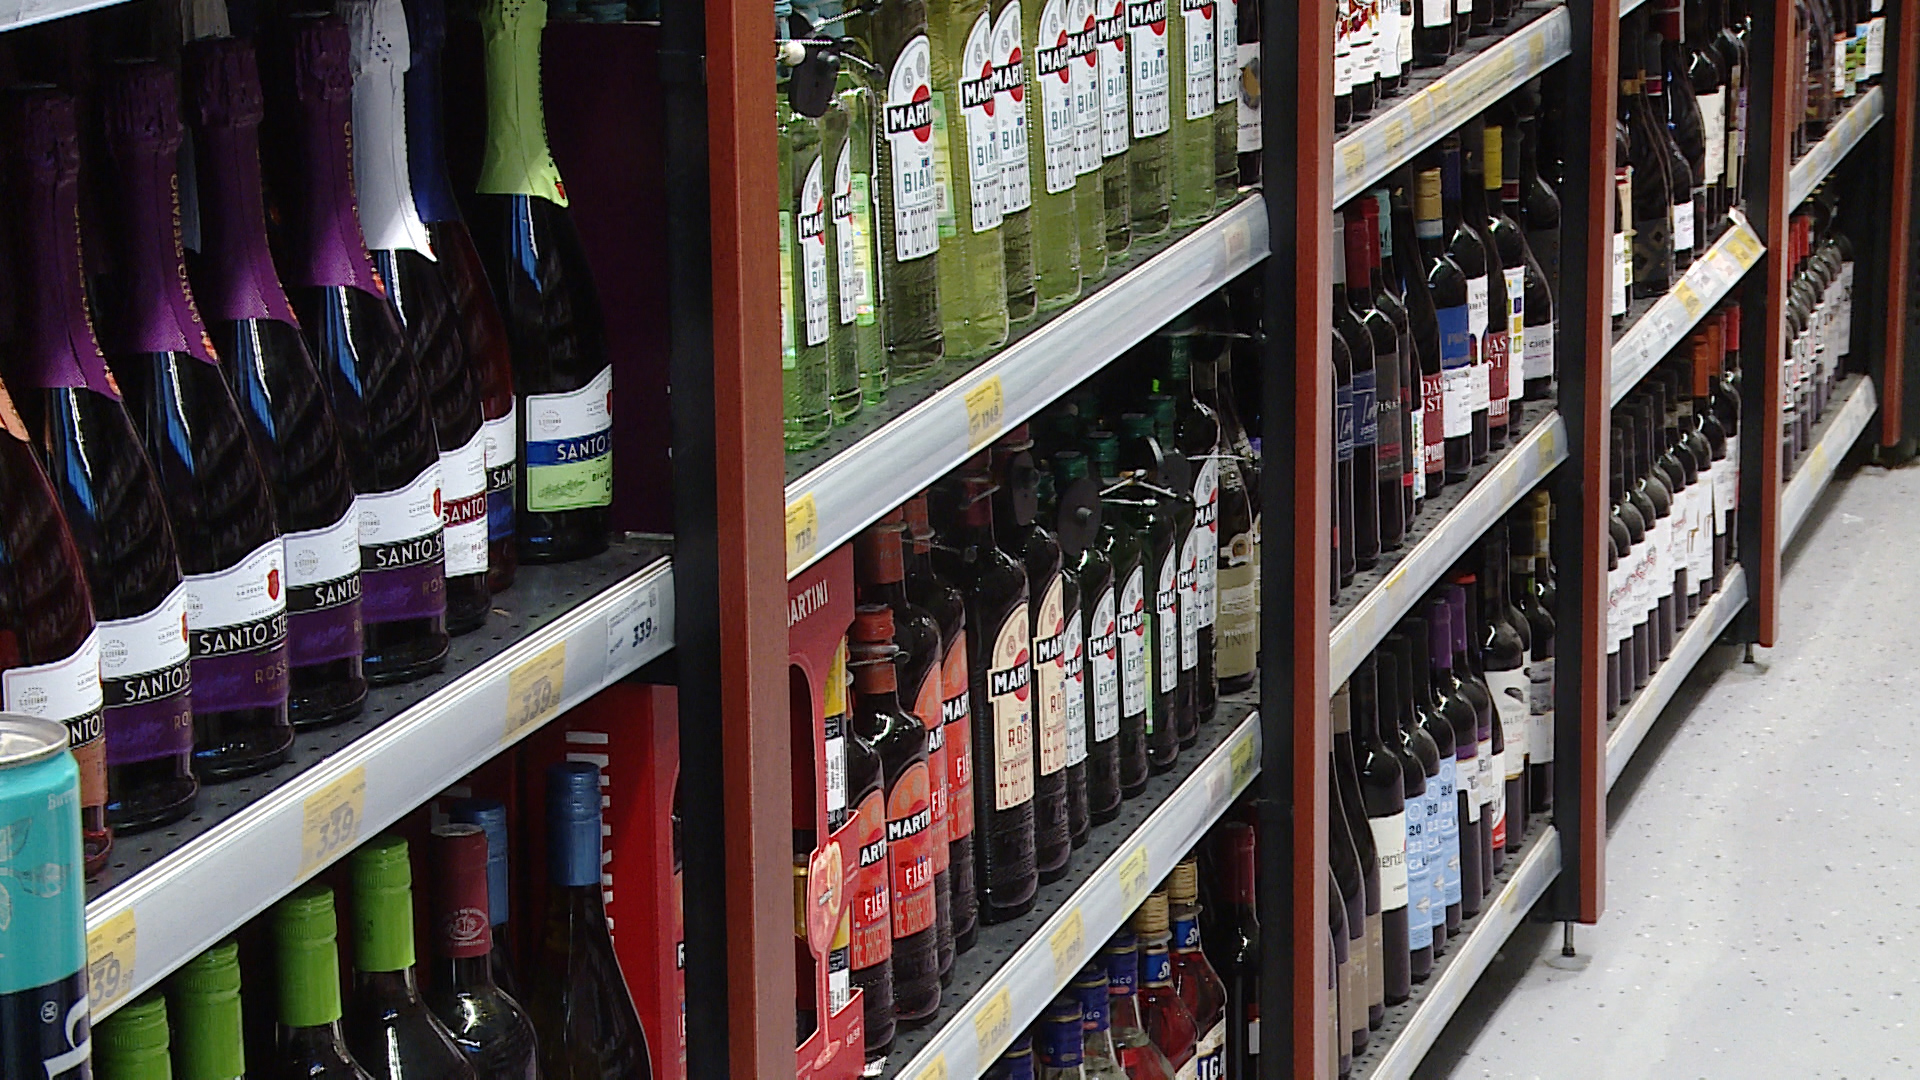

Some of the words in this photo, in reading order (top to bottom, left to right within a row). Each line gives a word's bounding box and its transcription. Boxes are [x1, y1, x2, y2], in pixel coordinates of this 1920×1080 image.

[557, 435, 606, 461] SANTO
[443, 497, 485, 523] SANTO
[376, 539, 433, 567] SANTO
[315, 574, 361, 606] SANTO
[200, 622, 268, 654] SANTO
[124, 668, 184, 702] SANTO
[71, 714, 101, 744] NTO
[316, 806, 354, 859] 339
